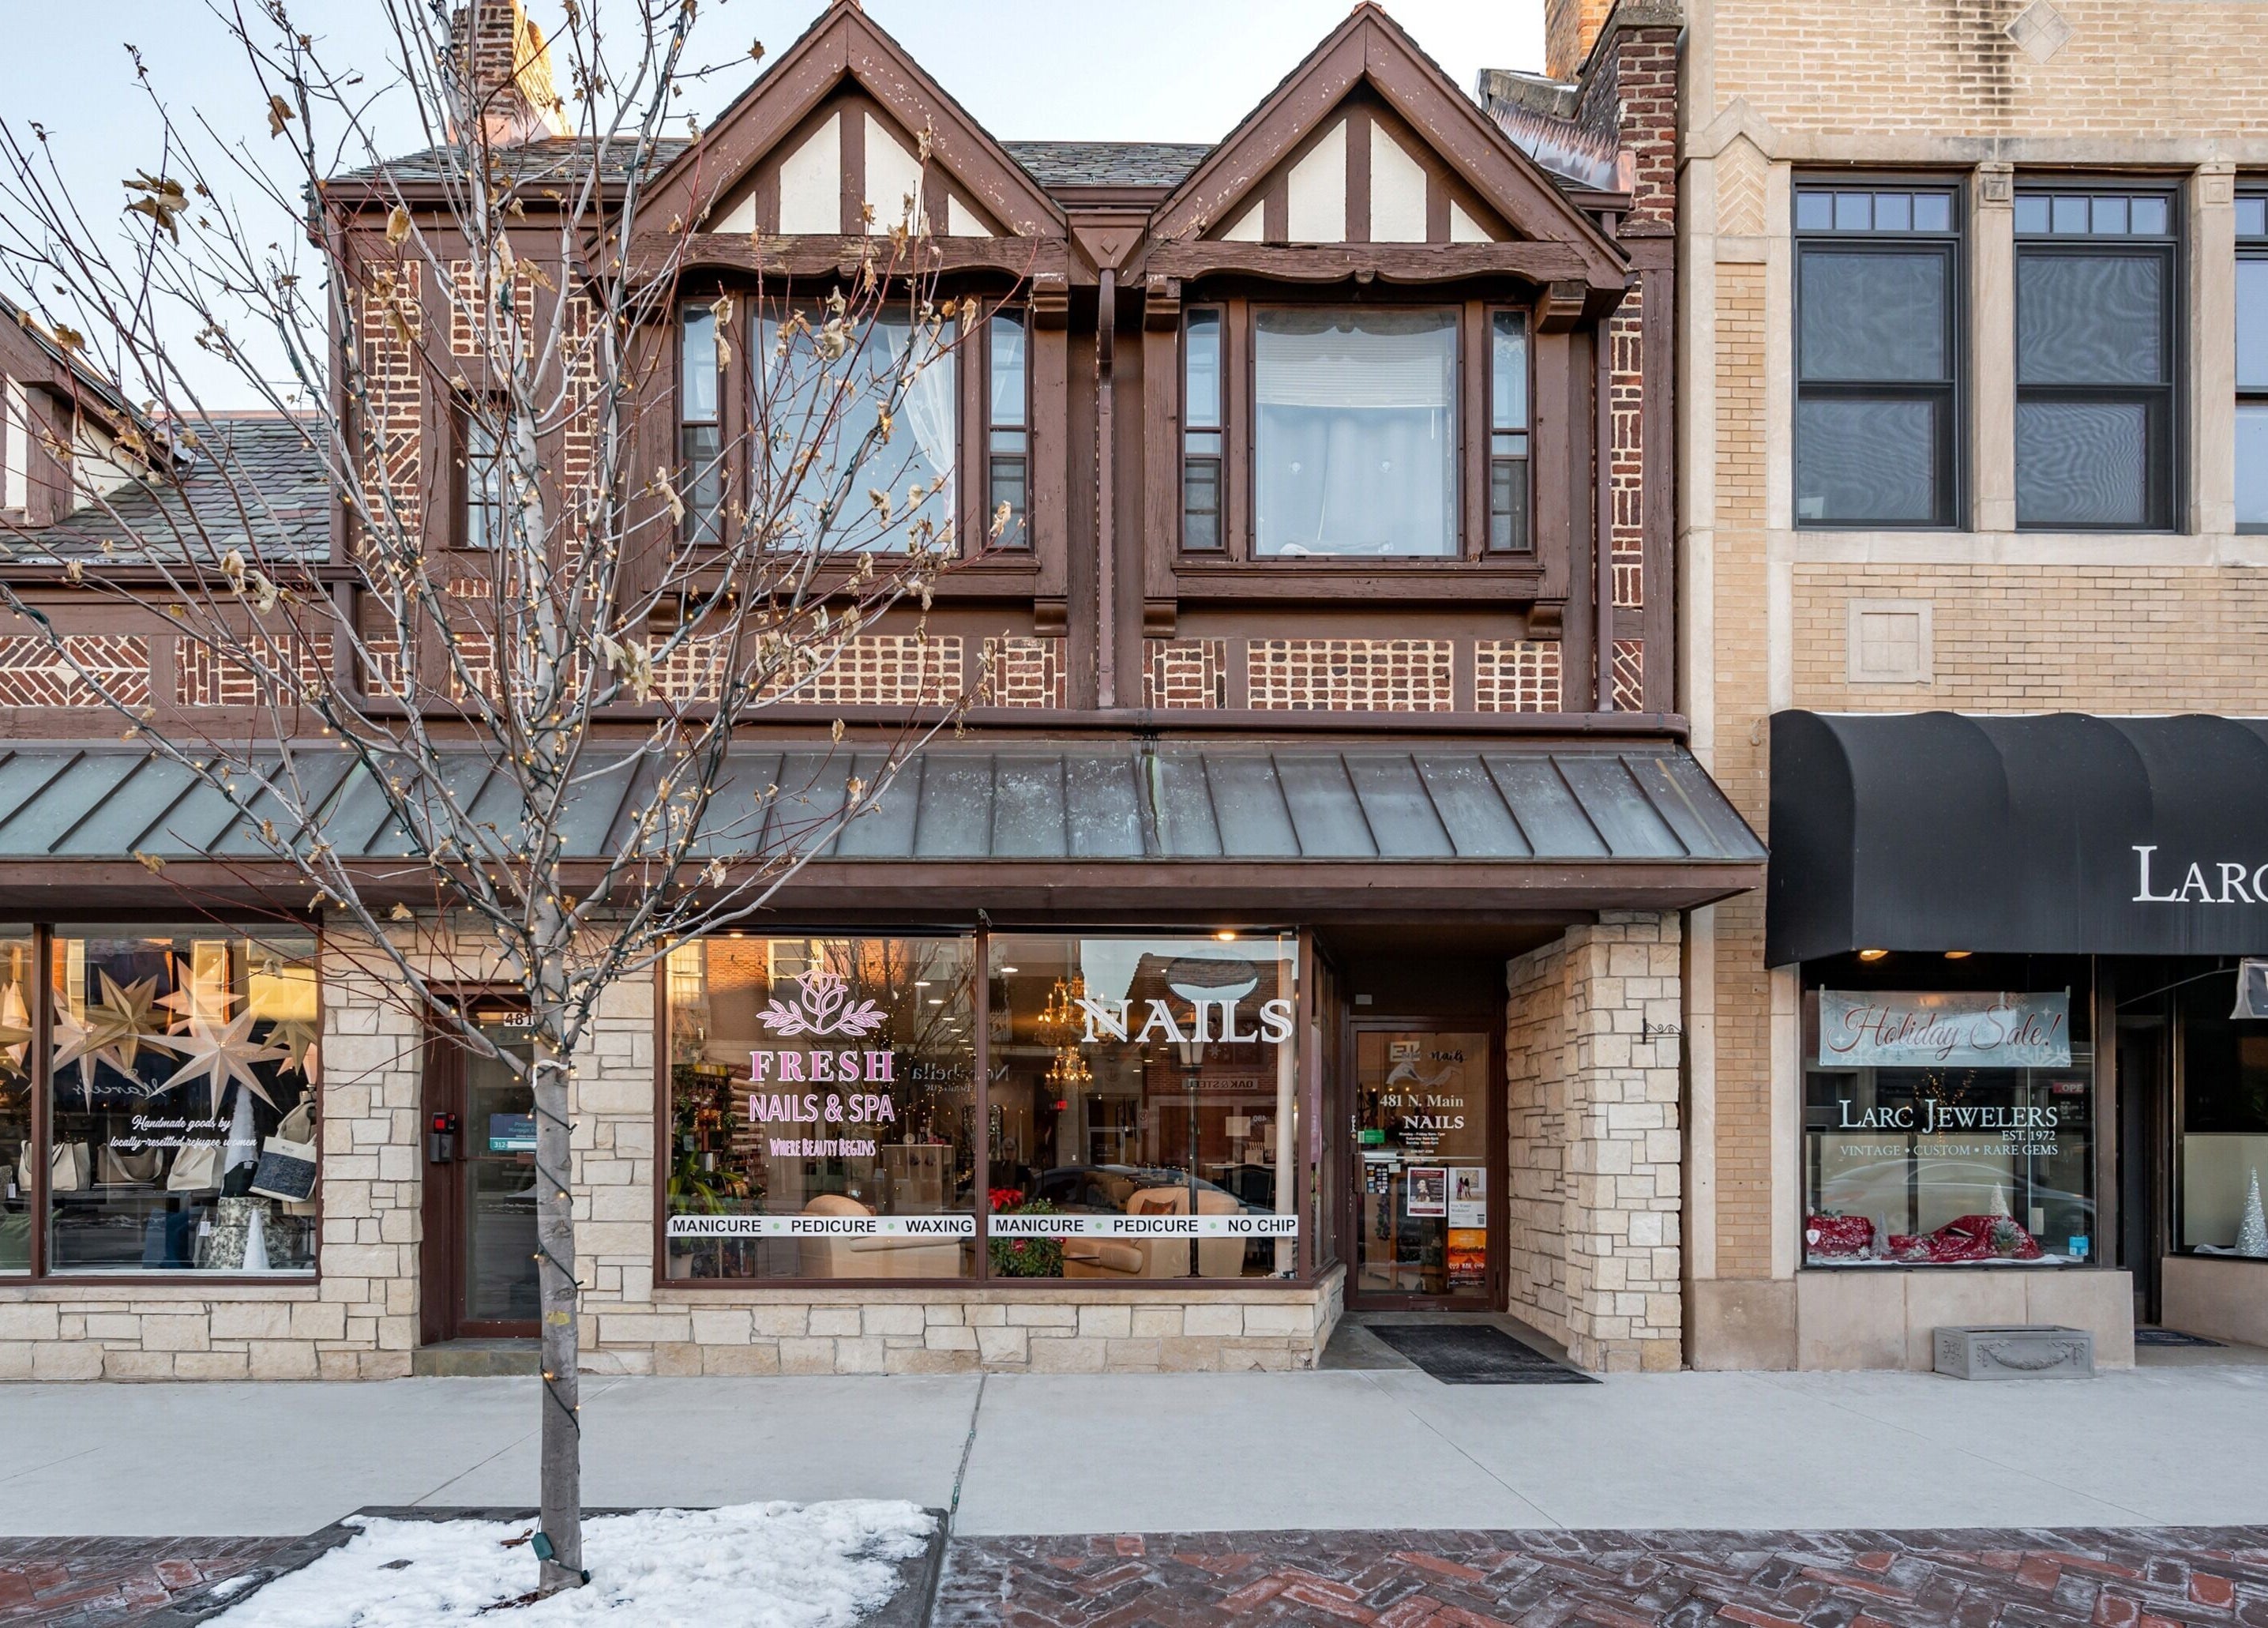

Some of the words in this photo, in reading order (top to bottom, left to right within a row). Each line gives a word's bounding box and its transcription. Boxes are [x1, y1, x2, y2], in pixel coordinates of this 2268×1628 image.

[505, 1013, 532, 1026] 481
[1074, 998, 1294, 1043] NAILS
[1826, 1004, 1960, 1061] Holiday
[1969, 1004, 2062, 1050] Sale!
[749, 1051, 896, 1082] FRESH
[2061, 1084, 2084, 1093] OPE
[1379, 1093, 1403, 1107] 481
[1407, 1094, 1422, 1107] N.
[1426, 1094, 1464, 1107] Main
[749, 1094, 819, 1122] NAILS
[824, 1094, 843, 1122] &
[848, 1094, 896, 1122] SPA
[131, 1115, 186, 1131] Handmade
[188, 1115, 216, 1132] goods
[217, 1116, 232, 1131] by
[1402, 1115, 1465, 1130] NAILS
[2002, 1130, 2026, 1141] EST.
[2030, 1130, 2056, 1141] 1972
[110, 1136, 183, 1150] locally-resettled
[186, 1137, 221, 1151] refugee
[223, 1138, 257, 1147] women
[1840, 1145, 1902, 1156] VINTAGE
[1913, 1145, 1970, 1156] CUSTOM
[1983, 1145, 2019, 1156] RARE
[2022, 1145, 2059, 1156] GEMS
[672, 1220, 762, 1233] MANICURE
[791, 1220, 877, 1233] PEDICURE
[905, 1220, 973, 1233] WAXING
[995, 1219, 1084, 1233] MANICURE
[1113, 1219, 1199, 1233] PEDICURE
[1227, 1219, 1252, 1232] NO
[1257, 1219, 1297, 1232] CHIP
